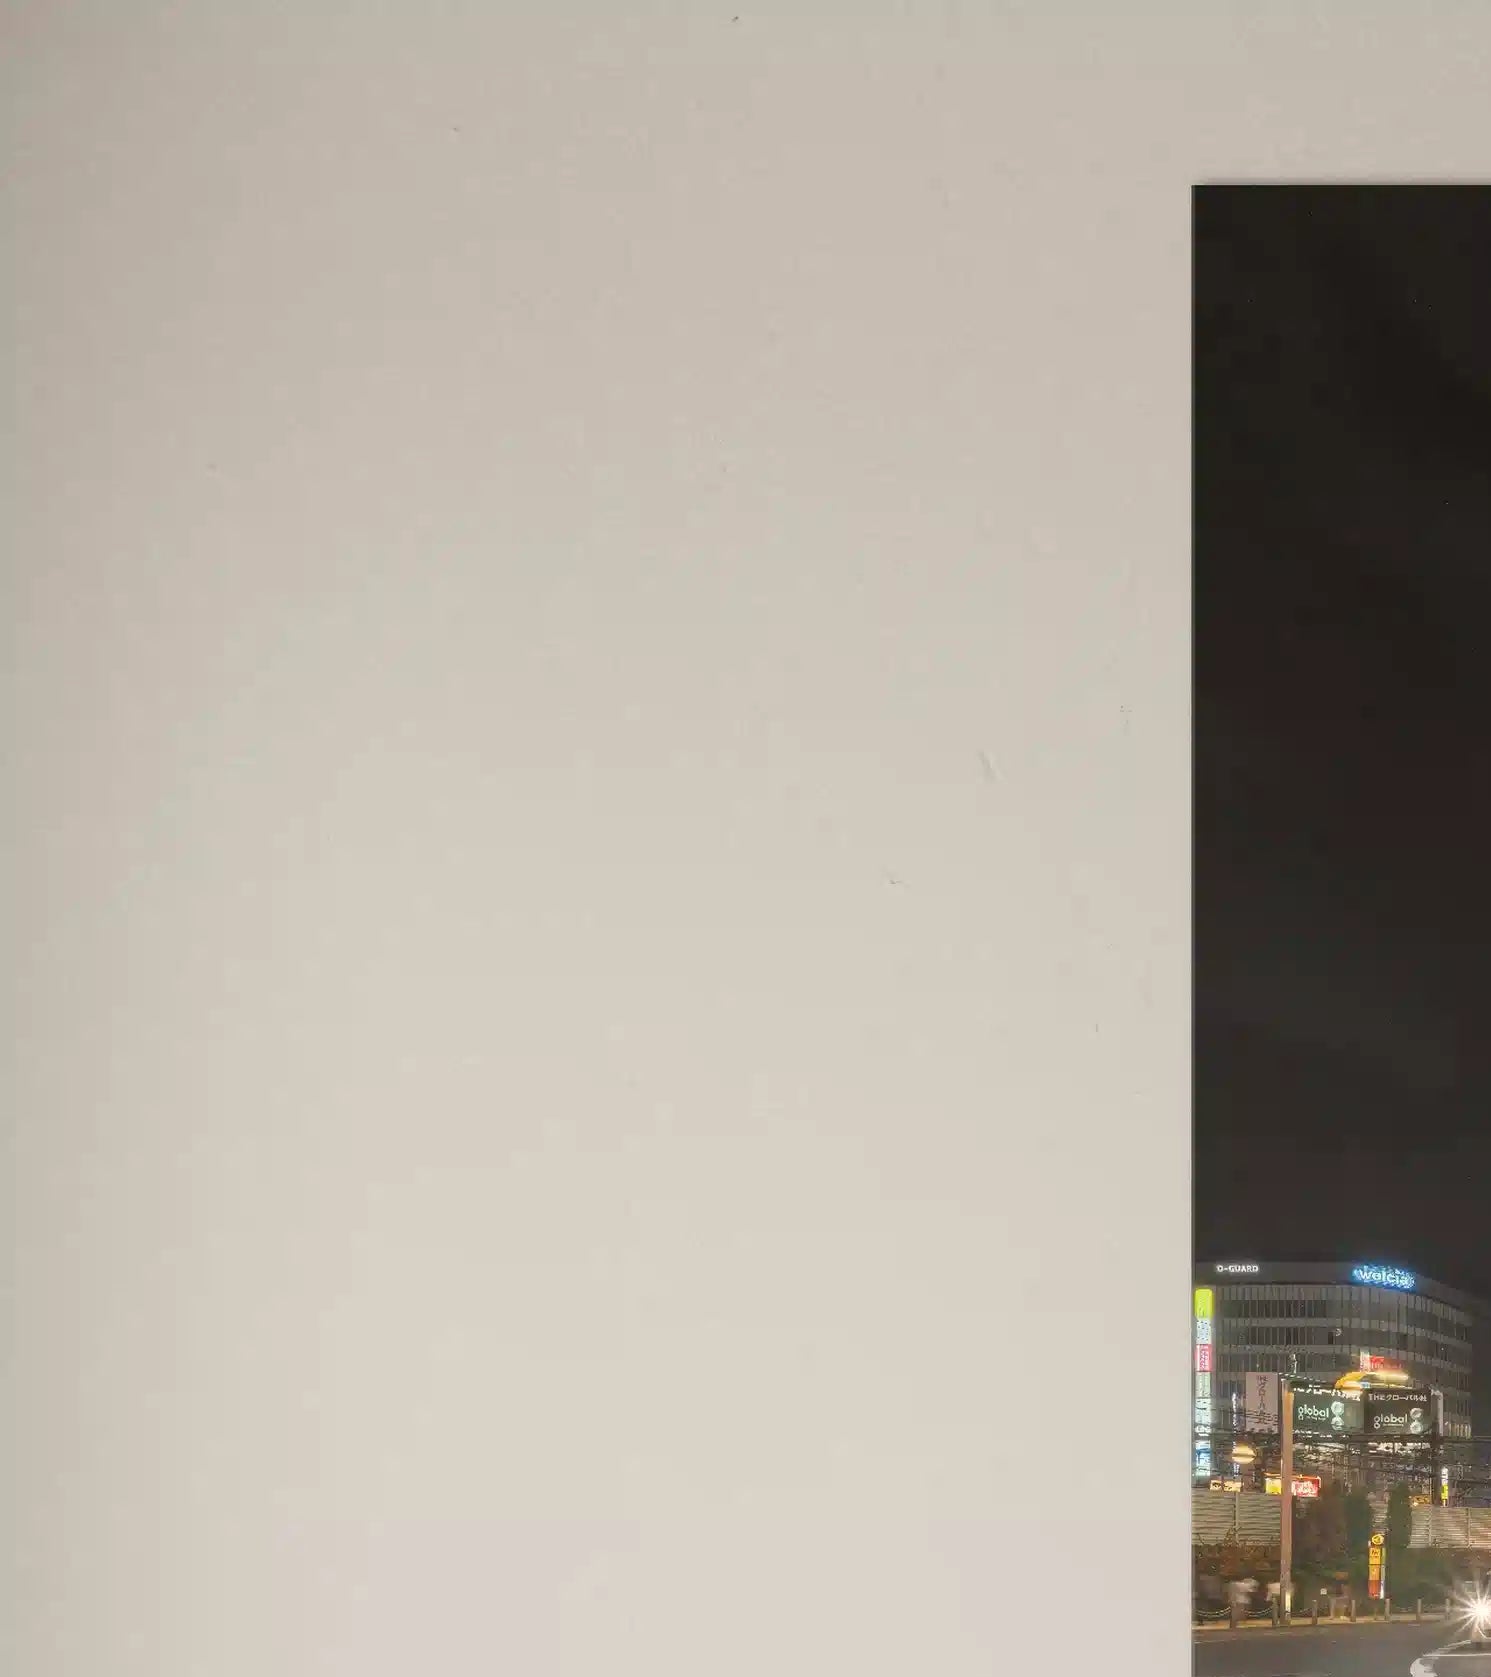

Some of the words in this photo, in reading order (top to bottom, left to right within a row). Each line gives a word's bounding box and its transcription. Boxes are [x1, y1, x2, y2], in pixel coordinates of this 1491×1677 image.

[1217, 1265, 1259, 1273] O-GUARD
[1298, 1404, 1330, 1421] global
[1373, 1414, 1408, 1430] global
